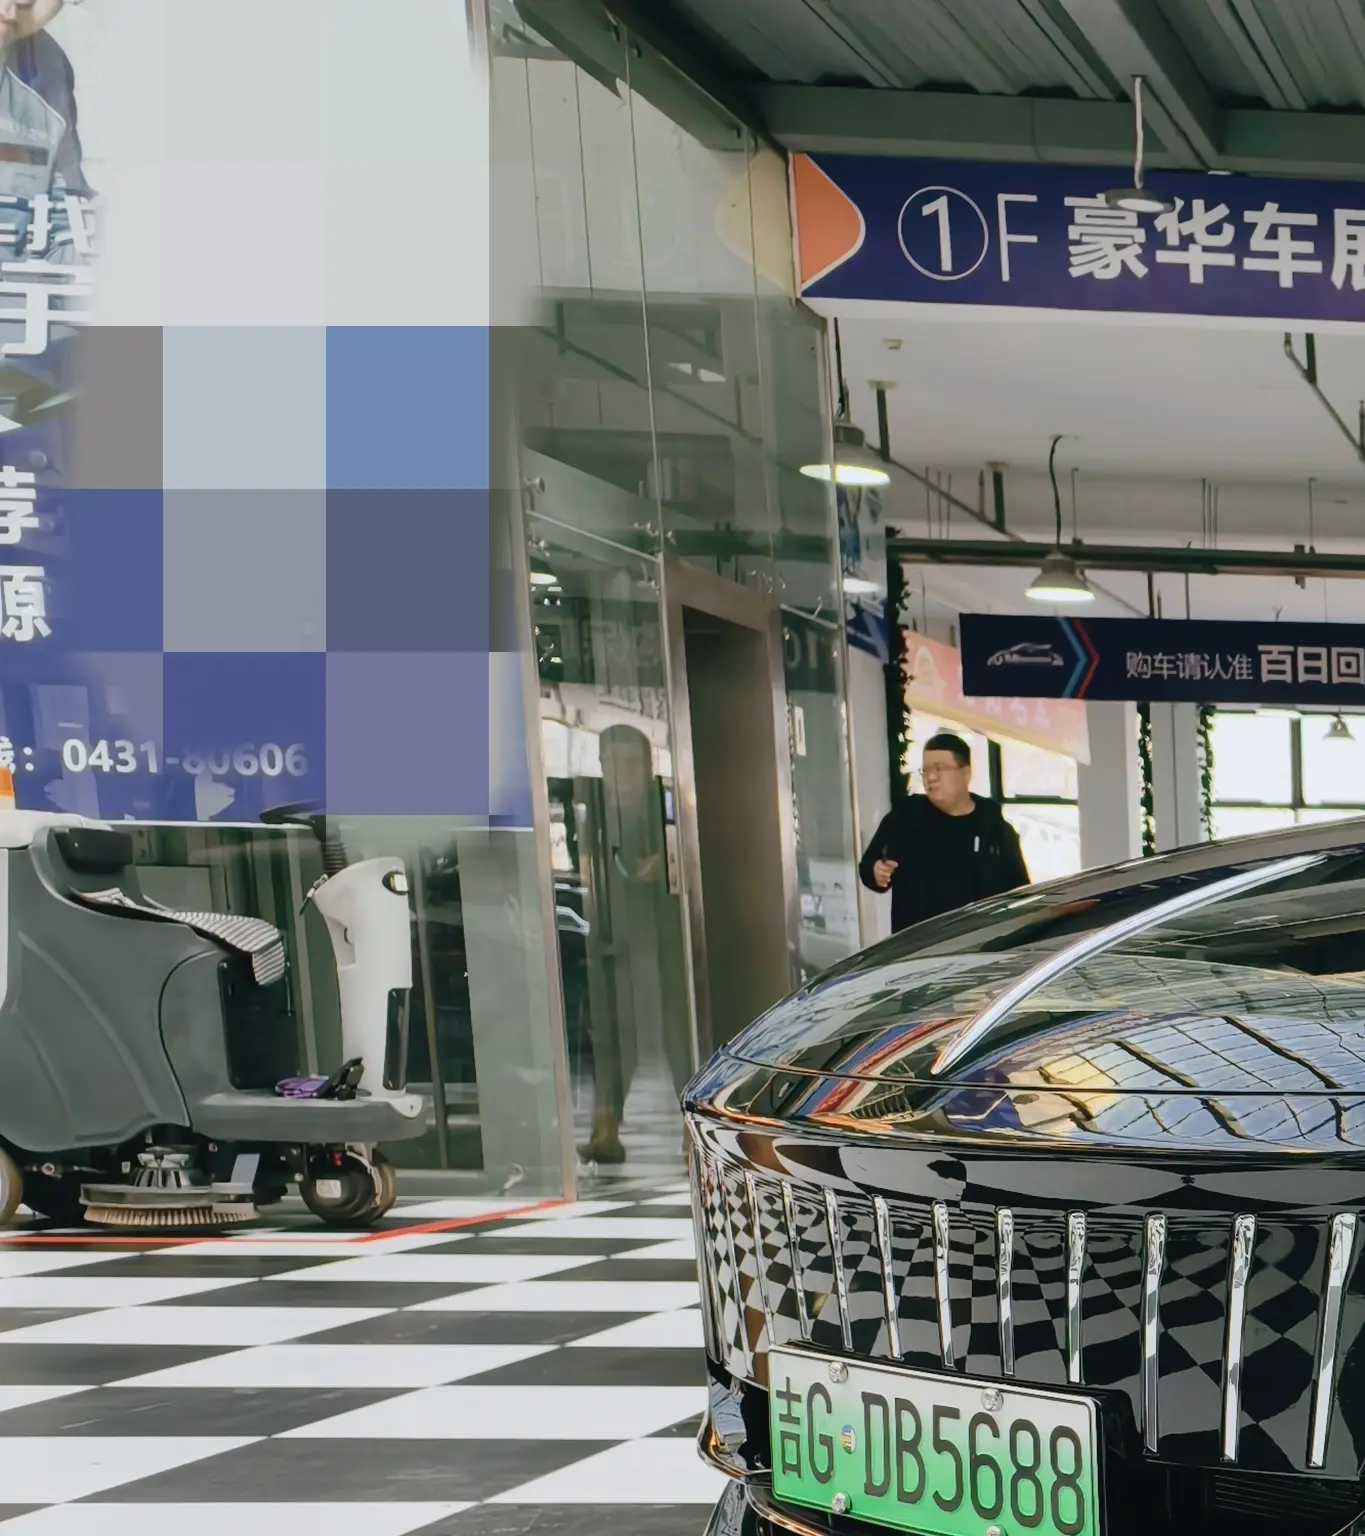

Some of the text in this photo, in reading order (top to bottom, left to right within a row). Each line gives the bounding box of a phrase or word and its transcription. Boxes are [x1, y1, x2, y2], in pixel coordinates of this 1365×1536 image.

[1126, 651, 1253, 681] 购车请认准
